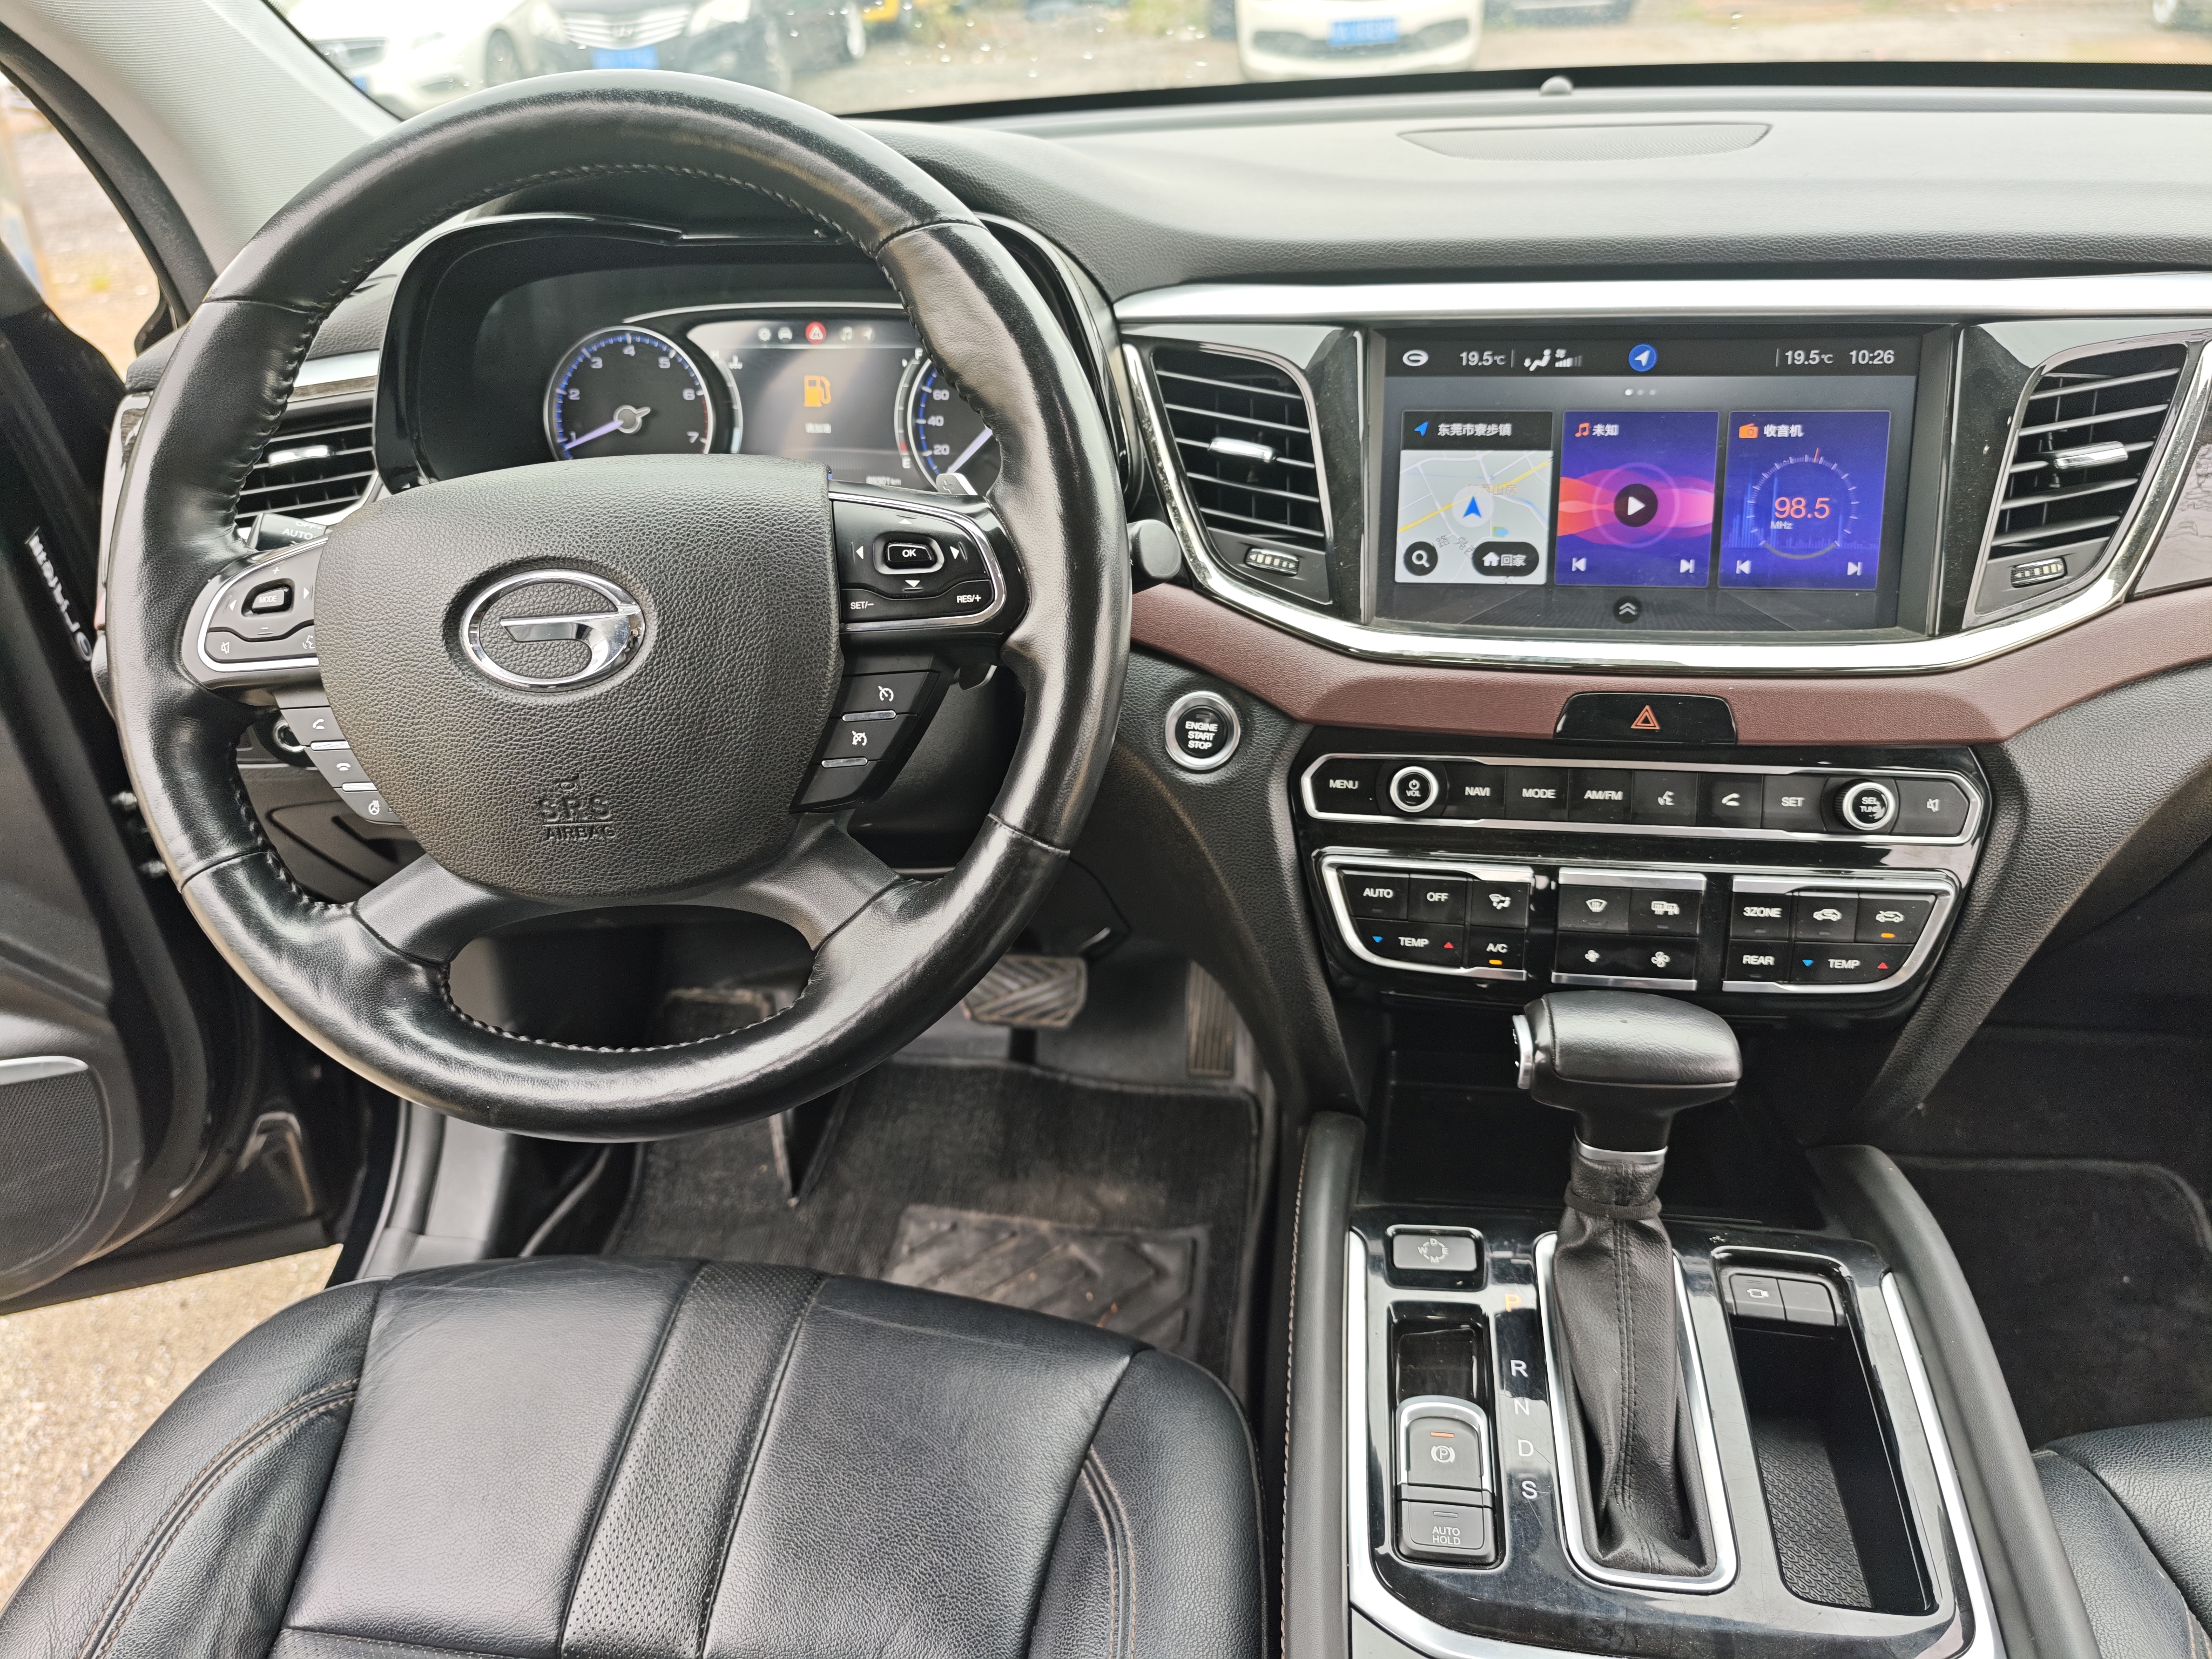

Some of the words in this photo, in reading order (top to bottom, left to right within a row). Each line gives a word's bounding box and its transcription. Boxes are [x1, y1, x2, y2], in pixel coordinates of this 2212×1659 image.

[623, 345, 636, 356] 4
[1849, 349, 1895, 365] 10:26
[591, 357, 603, 369] 3
[658, 357, 671, 369] 5
[568, 388, 581, 400] 2
[683, 388, 696, 401] 6
[933, 389, 949, 401] 60
[927, 415, 945, 427] 40
[1437, 423, 1513, 436] 东莞市寮步镇
[1592, 423, 1620, 437] 未知
[1763, 424, 1804, 438] 收音机
[687, 431, 699, 443] 7
[933, 444, 950, 455] 20
[902, 457, 911, 469] E
[1775, 497, 1830, 519] 98.5
[1770, 521, 1794, 530] MHz
[281, 528, 313, 540] AUTO
[902, 549, 916, 557] OK
[1500, 554, 1528, 567] 回家
[259, 595, 278, 604] MODE
[956, 595, 982, 604] RES/+
[1185, 721, 1218, 732] ENGINE
[1188, 731, 1216, 740] START
[1188, 740, 1212, 750] STOP
[1329, 779, 1358, 790] MENU
[1465, 787, 1491, 797] NAVI
[1522, 788, 1557, 799] MODE
[1584, 790, 1623, 800] AM/FM
[1781, 797, 1805, 807] SET
[1862, 797, 1880, 805] SEL
[546, 826, 617, 841] AIRBAG
[1363, 888, 1393, 899] AUTO
[1426, 892, 1449, 902] OFF
[1743, 907, 1782, 918] 3ZONE
[1398, 936, 1429, 947] TEMP
[1486, 943, 1508, 953] A/C
[1742, 955, 1775, 966] REAR
[1828, 959, 1861, 969] TEMP
[1418, 1246, 1428, 1255] W
[1504, 1293, 1522, 1312] P
[1510, 1359, 1527, 1378] R
[1514, 1397, 1530, 1415] N
[1519, 1439, 1534, 1456] D
[1521, 1480, 1538, 1500] S
[1432, 1526, 1460, 1536] AUTO
[1432, 1535, 1461, 1545] HOLD
